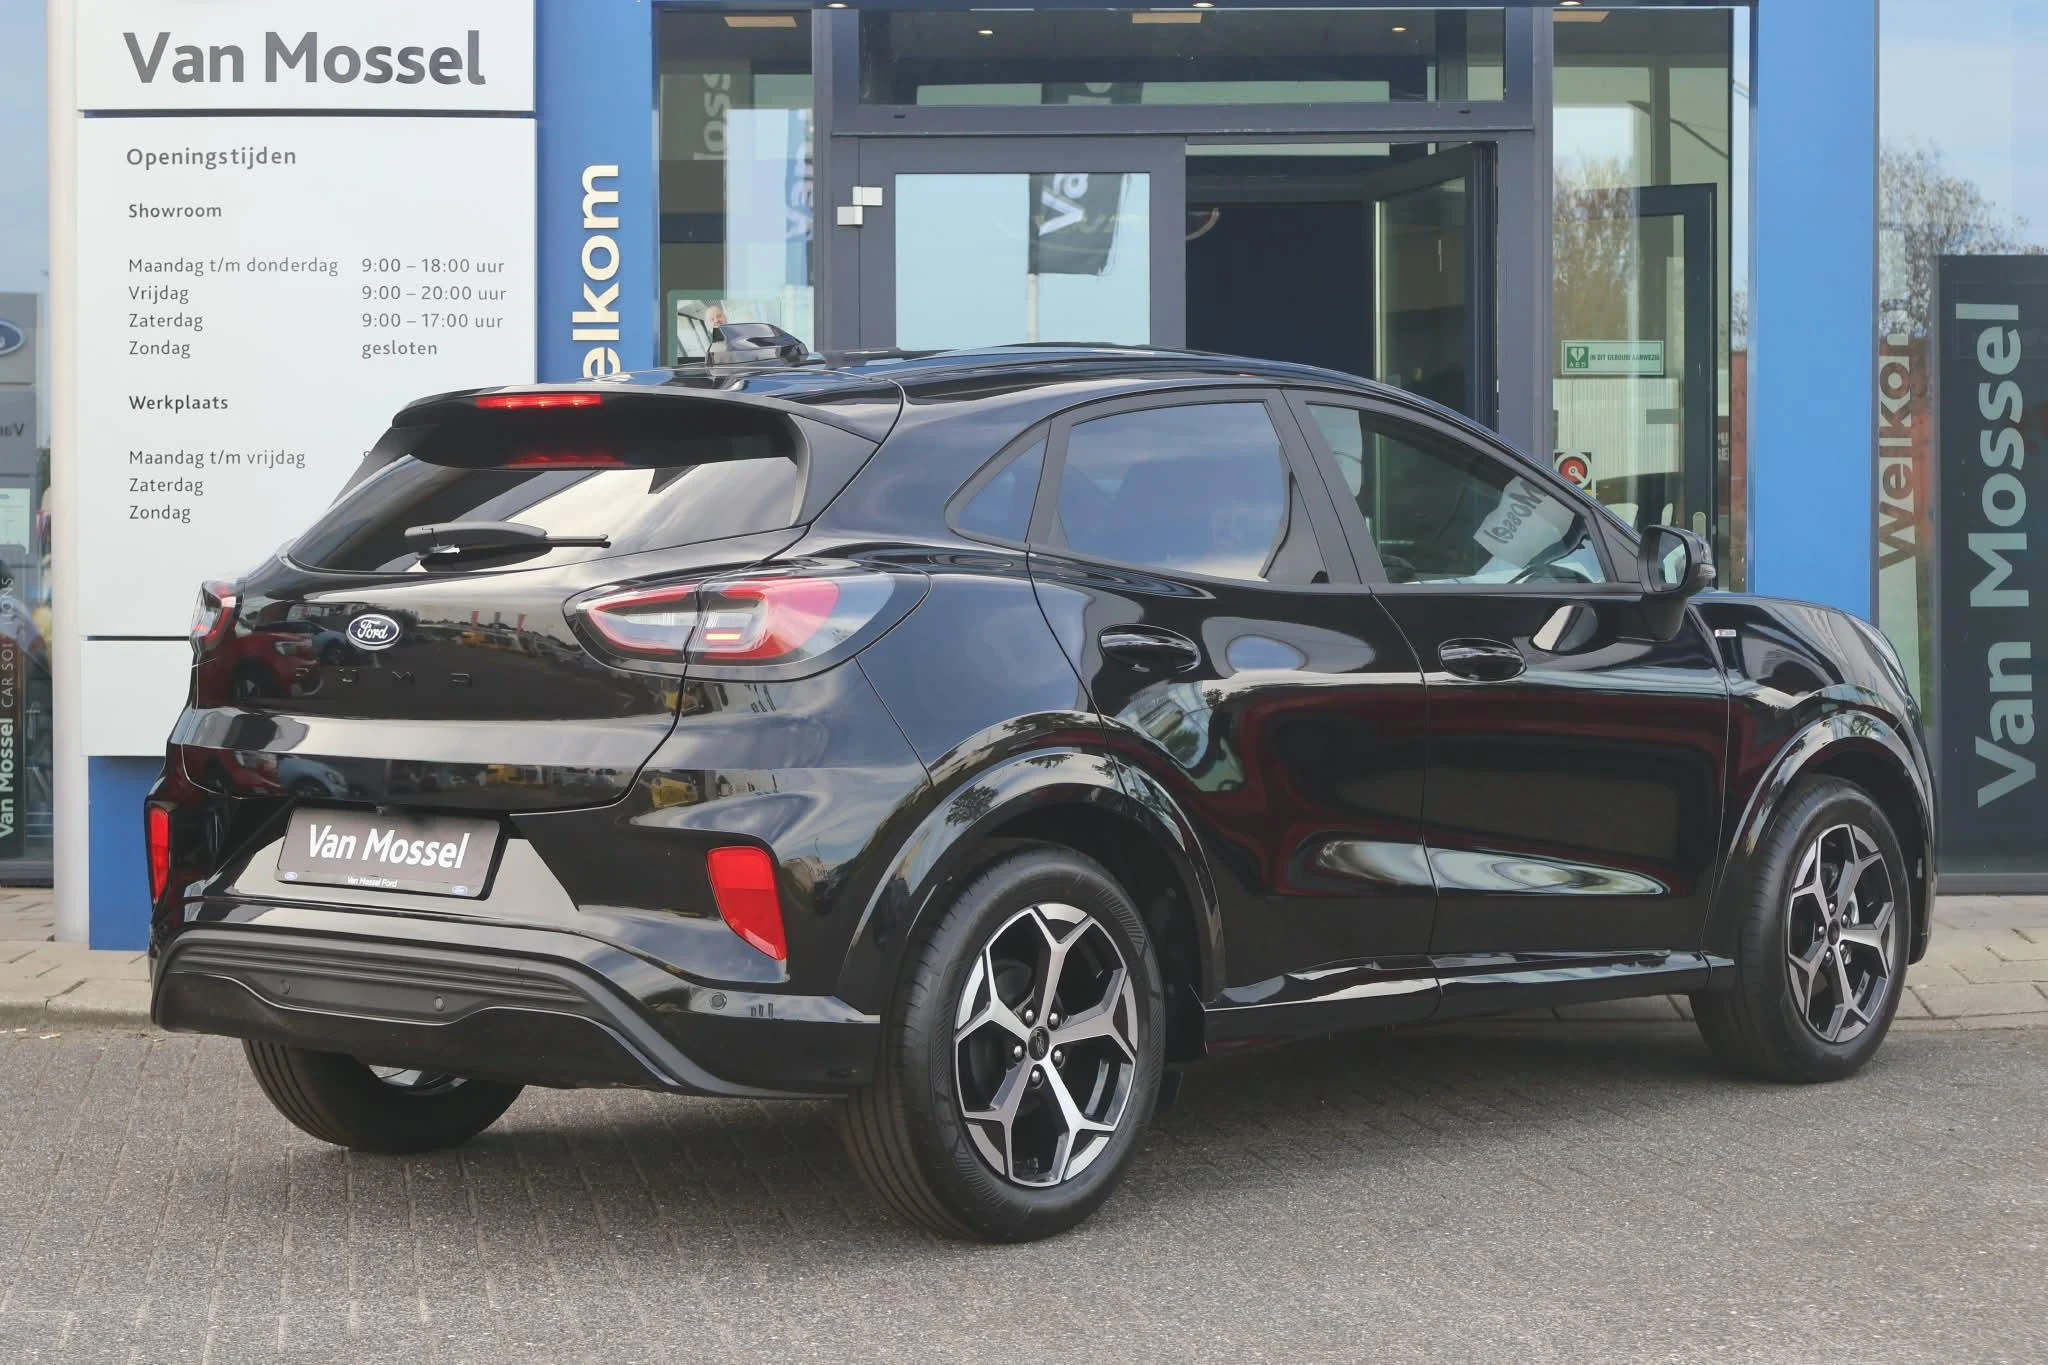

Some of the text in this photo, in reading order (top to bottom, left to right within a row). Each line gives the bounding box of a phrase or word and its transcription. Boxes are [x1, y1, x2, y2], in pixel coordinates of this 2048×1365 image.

[122, 30, 487, 85] Van Mossel
[126, 146, 296, 170] Openingstijden
[128, 203, 222, 219] Showroom
[1038, 173, 1088, 237] Va
[128, 257, 339, 277] Maandag t/m donderdag
[361, 258, 401, 273] 9:00
[421, 258, 470, 273] 18:00
[476, 262, 505, 274] uur
[572, 164, 621, 380] elkom
[128, 285, 190, 305] Vrijdag
[361, 285, 401, 300] 9:00
[421, 285, 472, 301] 20:00
[478, 289, 507, 301] uur
[128, 312, 204, 333] Zaterdag
[361, 313, 401, 328] 9:00
[421, 313, 469, 329] 17:00
[474, 317, 504, 329] uur
[128, 340, 191, 360] Zondag
[361, 340, 438, 360] gesloten
[128, 393, 229, 415] Werkplaats
[129, 449, 306, 470] Maandag t/m vrijdag
[129, 477, 204, 497] Zaterdag
[129, 504, 192, 524] Zondag
[1955, 303, 2037, 808] Van Mossel
[357, 618, 389, 640] Ford
[1, 677, 14, 708] CAR
[0, 717, 14, 793] Mossel
[0, 798, 14, 838] Van
[309, 823, 471, 869] Van Mossel
[347, 875, 398, 888] Van Mossel Ford
